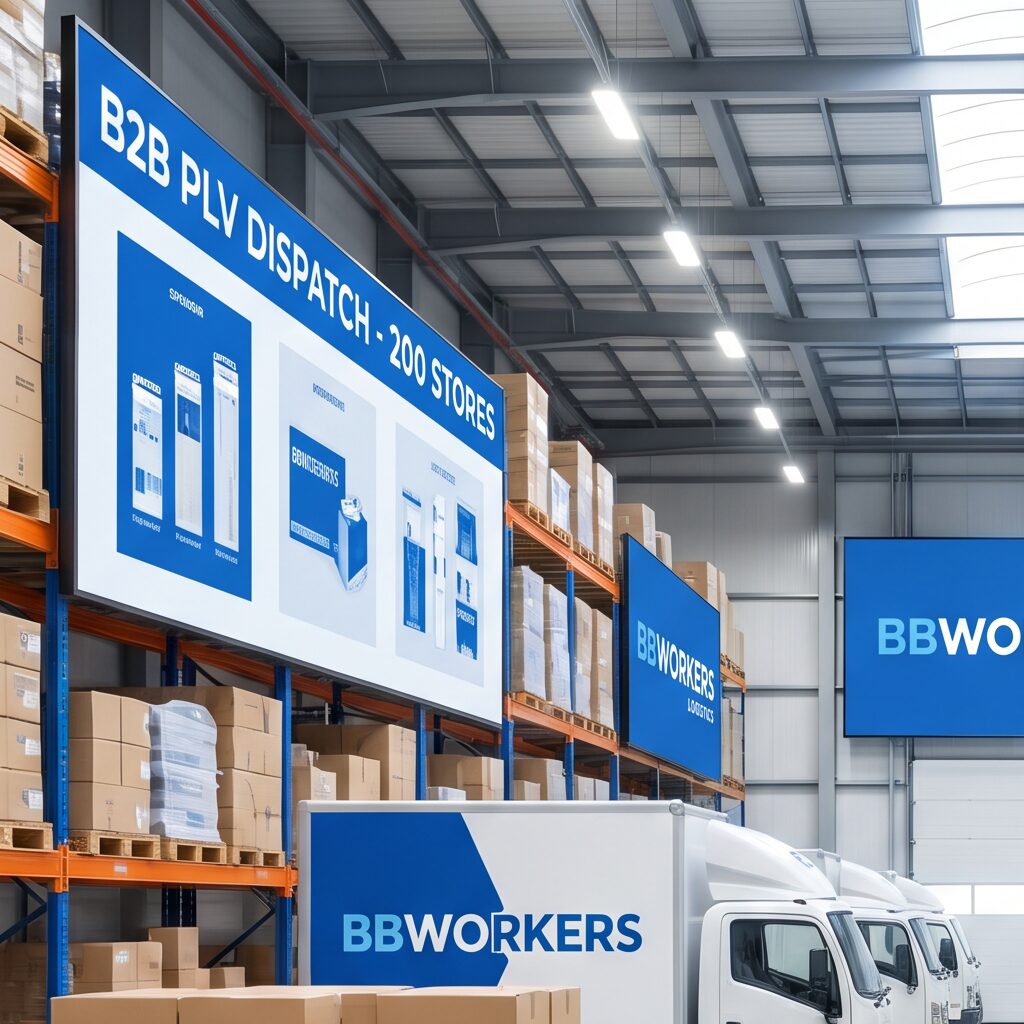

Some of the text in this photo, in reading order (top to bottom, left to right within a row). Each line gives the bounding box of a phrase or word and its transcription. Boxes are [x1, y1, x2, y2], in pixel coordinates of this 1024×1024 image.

[101, 84, 170, 188] B2B
[181, 150, 239, 239] PLV
[247, 205, 370, 345] DISPATCH
[389, 324, 426, 386] 200
[431, 358, 496, 441] STORES
[637, 620, 715, 702] BBWORKERS
[343, 913, 643, 953] BBWORKERS
